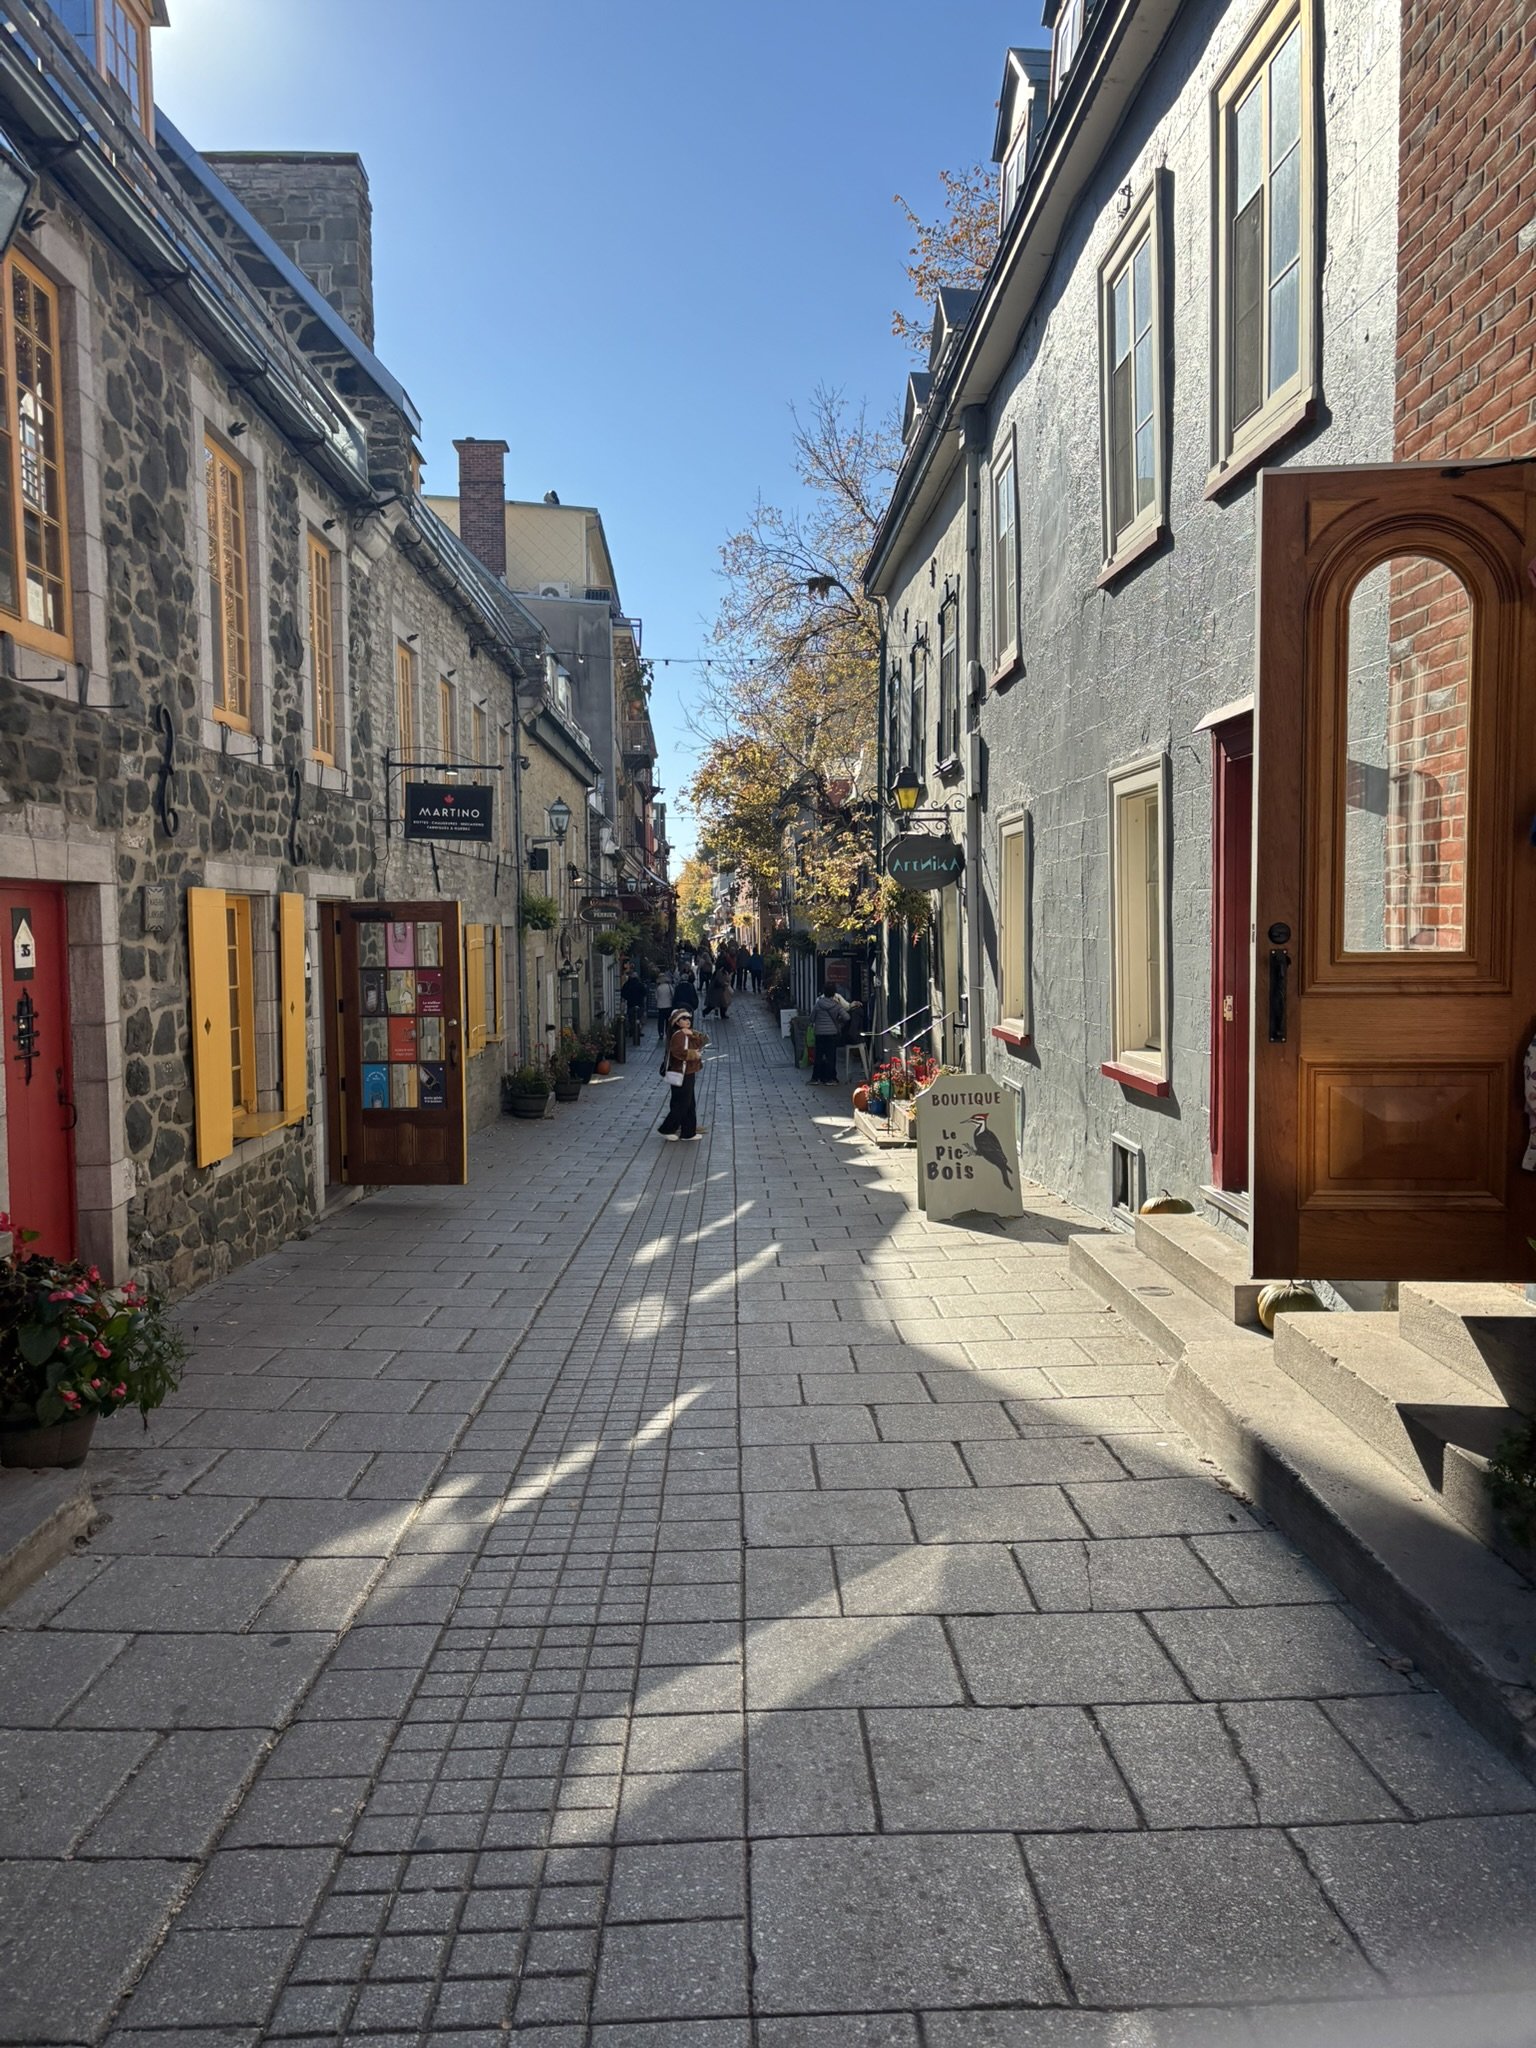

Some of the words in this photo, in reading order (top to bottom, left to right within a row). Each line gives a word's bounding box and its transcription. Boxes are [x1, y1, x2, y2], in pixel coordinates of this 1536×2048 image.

[419, 807, 480, 818] MARTINO
[20, 943, 31, 957] 35
[932, 1092, 1001, 1106] BOUTIQUE
[942, 1129, 957, 1140] Le
[936, 1146, 968, 1160] Pic-
[926, 1162, 974, 1181] Bois
